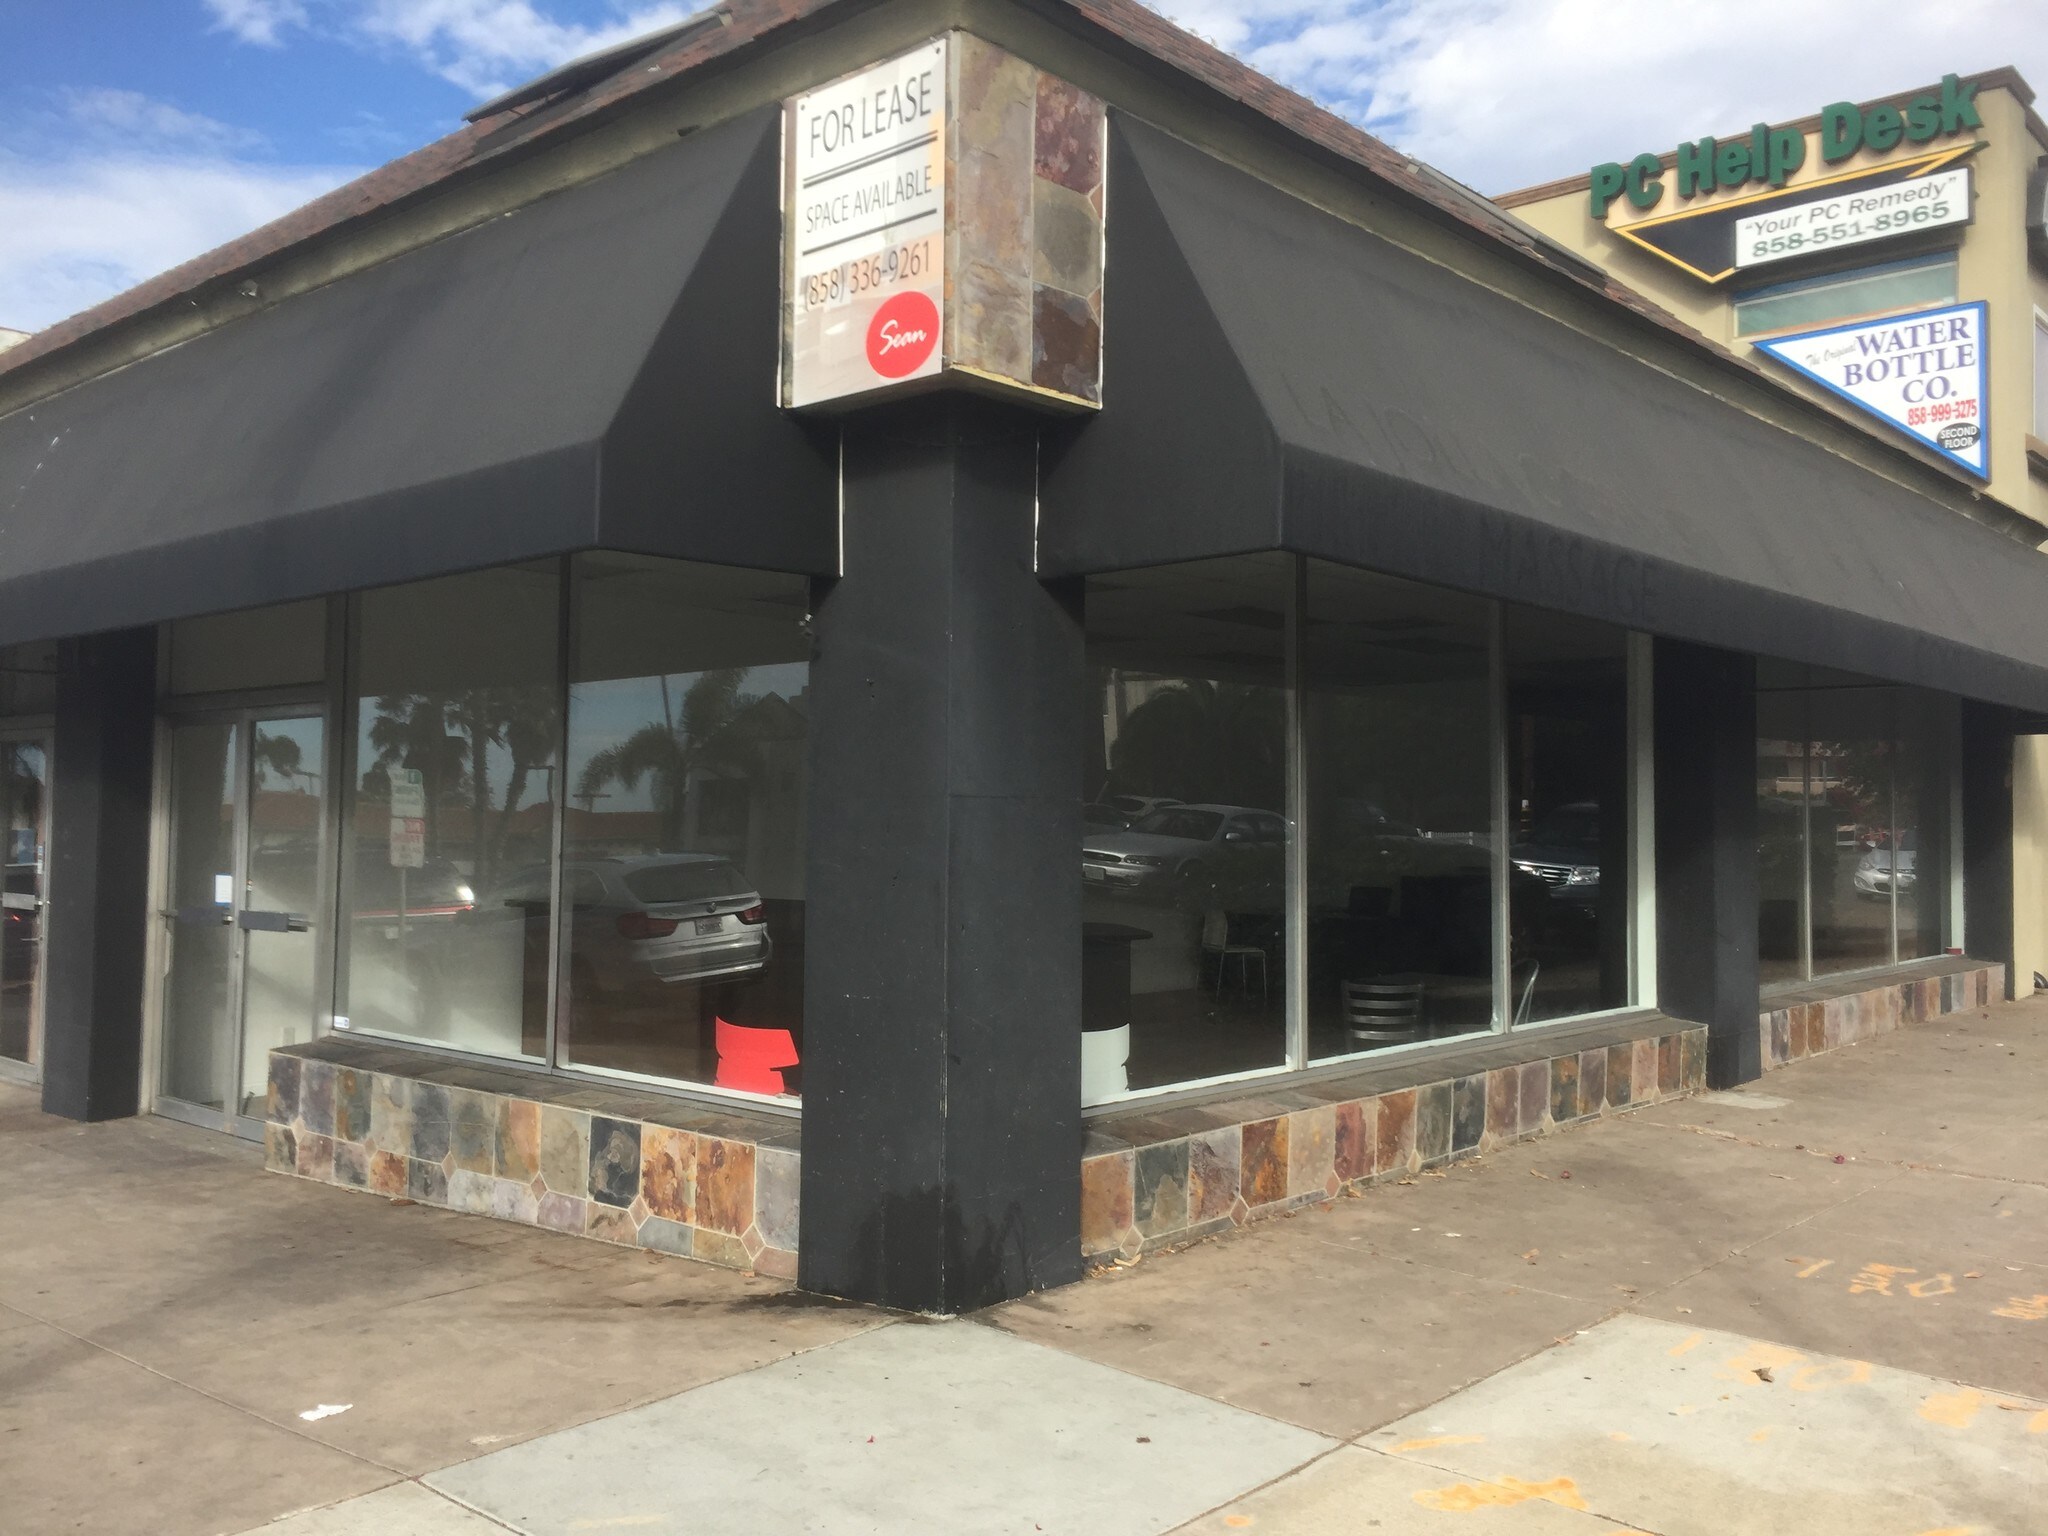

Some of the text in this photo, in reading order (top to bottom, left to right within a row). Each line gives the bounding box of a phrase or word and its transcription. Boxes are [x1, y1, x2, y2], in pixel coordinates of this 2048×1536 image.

[810, 71, 932, 157] FOR LEASE
[1590, 73, 1984, 219] PC Help Desk
[806, 165, 932, 233] SPACE AVAILABLE
[1808, 204, 1841, 225] PC
[1752, 201, 1950, 258] 858-551-8965
[805, 240, 930, 313] (858) 336-9261
[879, 319, 927, 355] Sean
[1856, 317, 1971, 357] WATER
[1843, 343, 1976, 387] BOTTLE
[1902, 375, 1958, 403] CO.
[1907, 399, 1977, 426] 858-999-3275
[1940, 426, 1977, 439] SECOND
[1944, 437, 1974, 448] FLOOR
